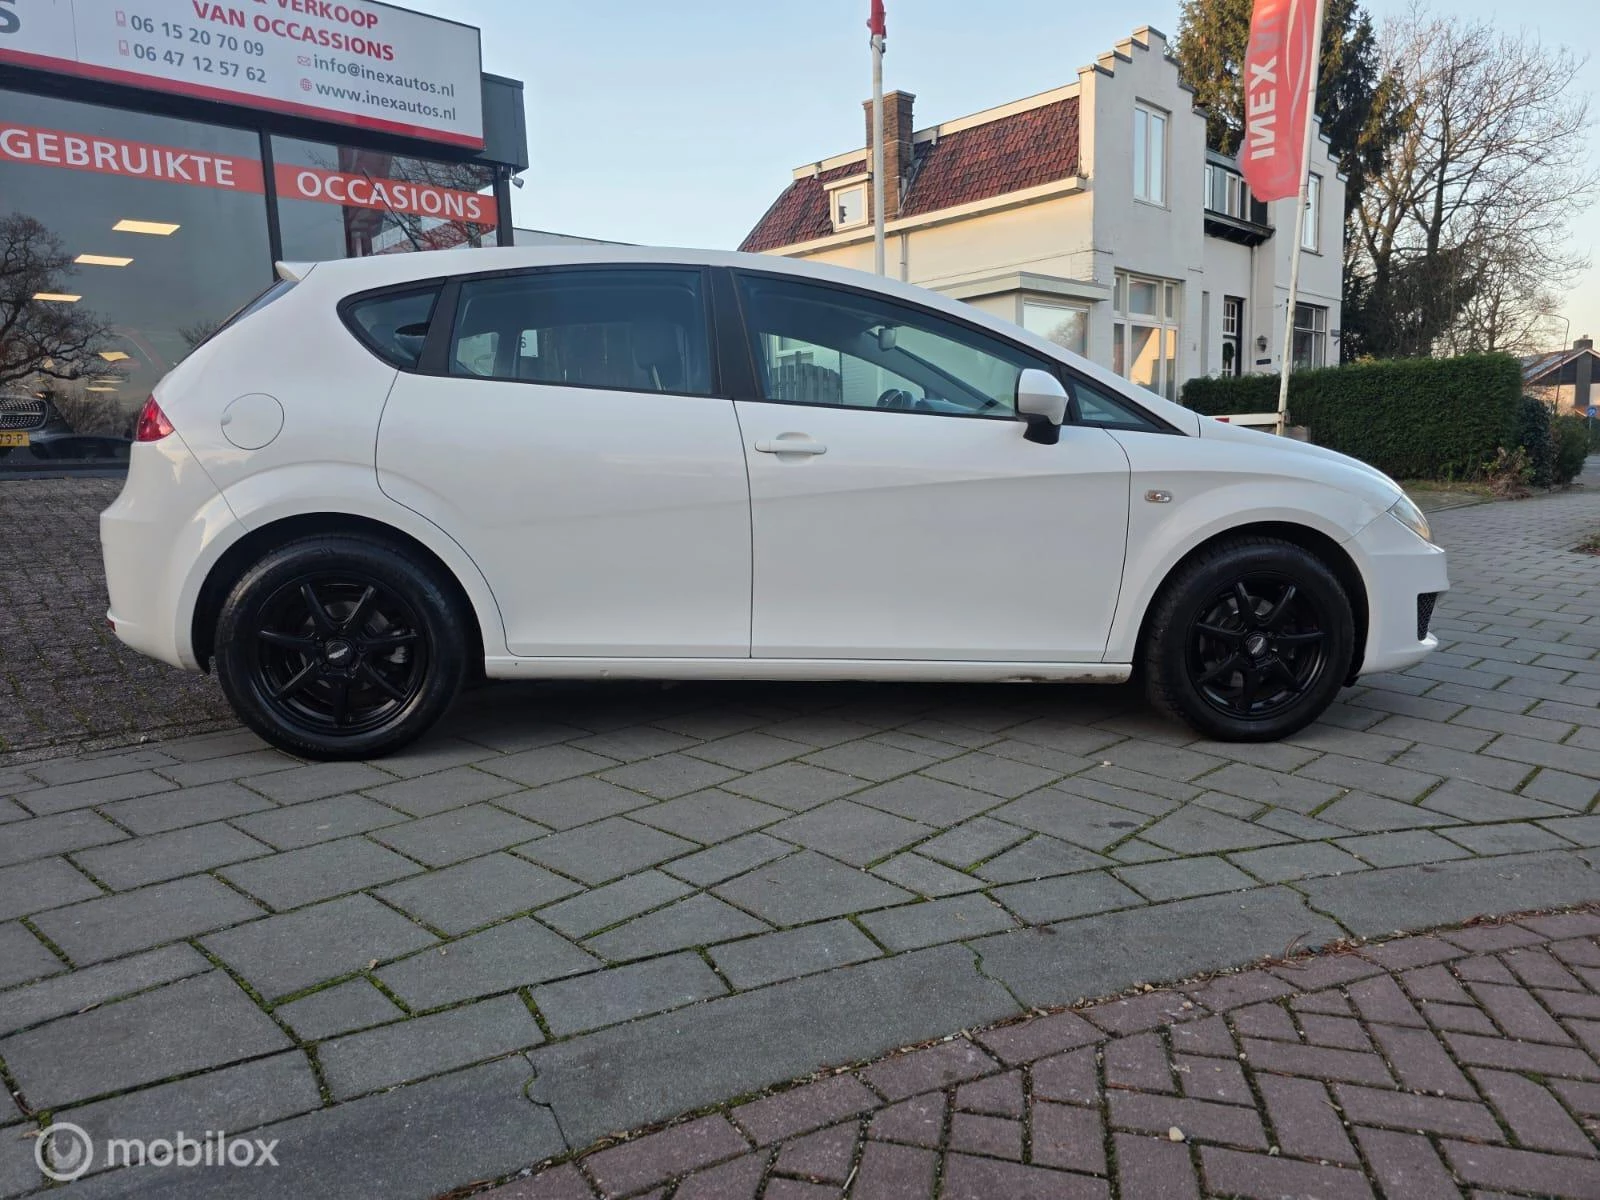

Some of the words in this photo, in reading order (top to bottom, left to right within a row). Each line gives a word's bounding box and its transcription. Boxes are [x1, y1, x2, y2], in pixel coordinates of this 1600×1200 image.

[130, 15, 154, 33] 06
[162, 22, 183, 39] 15
[189, 27, 211, 45] 20
[216, 33, 238, 51] 70
[244, 39, 264, 56] 09
[192, 0, 245, 28] VAN
[253, 14, 394, 61] OCCASSIONS
[133, 43, 157, 61] 06
[163, 50, 184, 67] 47
[193, 56, 213, 73] 12
[219, 61, 239, 78] 57
[246, 67, 267, 83] 62
[314, 54, 455, 97] info@inexautos.nl
[315, 82, 456, 121] www.inexautos.nl
[0, 128, 235, 186] GEBRUIKTE
[297, 171, 481, 219] OCCASIONS
